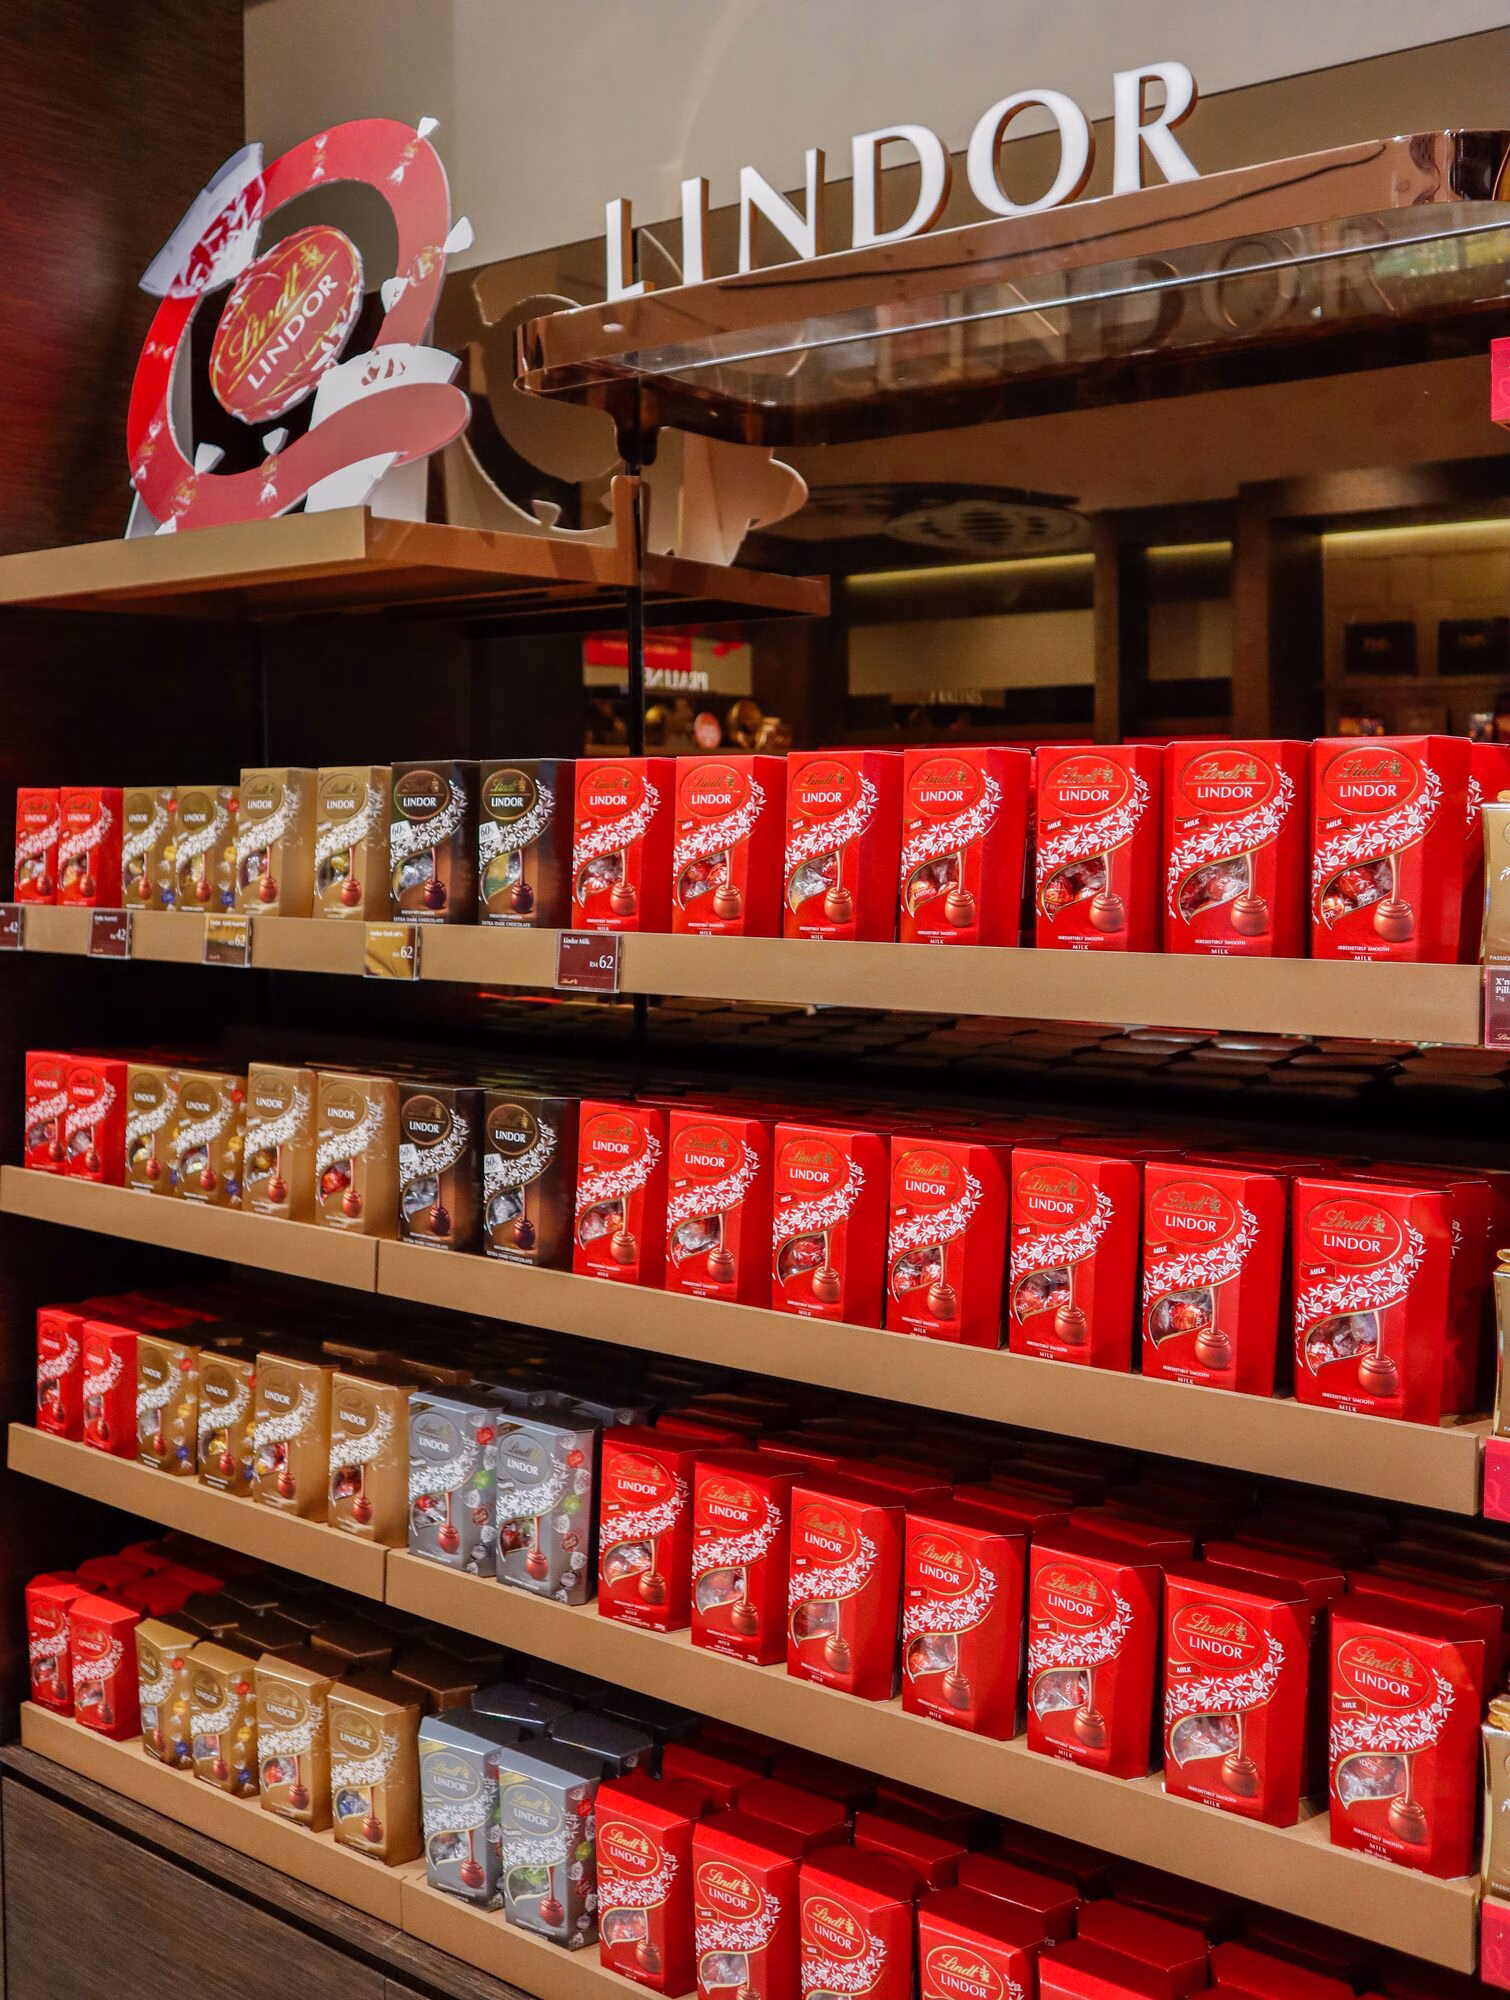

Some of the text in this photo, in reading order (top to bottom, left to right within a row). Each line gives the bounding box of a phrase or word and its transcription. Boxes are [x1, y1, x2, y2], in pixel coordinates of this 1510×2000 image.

[605, 61, 1199, 301] LINDOR
[228, 262, 299, 372] Lindt
[248, 274, 338, 389] LINDOR
[1056, 766, 1099, 784] Lindt
[1194, 763, 1243, 781] Lindt
[1339, 759, 1388, 778] Lindt
[802, 791, 842, 803] LINDOR
[920, 790, 964, 801] LINDOR
[1059, 789, 1109, 801] LINDOR
[1197, 786, 1252, 799] LINDOR
[1340, 784, 1397, 797] LINDOR
[247, 800, 272, 809] LINDOR
[326, 799, 355, 810] LINDOR
[403, 796, 436, 807] LINDOR
[491, 796, 523, 807] LINDOR
[589, 794, 627, 805] LINDOR
[691, 794, 731, 805] LINDOR
[909, 821, 923, 829] MILK
[1047, 820, 1062, 829] MILK
[1183, 819, 1200, 828] MILK
[1326, 818, 1343, 829] MILK
[116, 928, 126, 941] 42
[234, 934, 246, 946] 62
[400, 945, 413, 959] 62
[599, 955, 613, 969] 62
[1496, 986, 1510, 994] Pill
[256, 1098, 283, 1109] LINDOR
[327, 1108, 355, 1120] LINDOR
[409, 1121, 439, 1134] LINDOR
[495, 1130, 526, 1143] LINDOR
[592, 1141, 629, 1154] LINDOR
[685, 1154, 725, 1168] LINDOR
[790, 1168, 830, 1183] LINDOR
[905, 1180, 946, 1195] LINDOR
[1027, 1175, 1066, 1193] Lindt
[1029, 1198, 1074, 1214] LINDOR
[1163, 1192, 1210, 1211] Lindt
[1165, 1216, 1216, 1233] LINDOR
[1321, 1210, 1372, 1230] Lindt
[1018, 1227, 1031, 1235] MILK
[1153, 1245, 1168, 1254] MILK
[1323, 1234, 1381, 1252] LINDOR
[1310, 1266, 1326, 1276] MILK
[1178, 1376, 1194, 1385] MILK
[264, 1390, 290, 1404] LINDOR
[1339, 1404, 1357, 1412] MILK
[340, 1412, 366, 1427] LINDOR
[419, 1437, 449, 1452] LINDOR
[507, 1458, 538, 1475] LINDOR
[617, 1479, 657, 1496] LINDOR
[709, 1504, 749, 1521] LINDOR
[804, 1532, 843, 1554] LINDOR
[919, 1563, 960, 1585] LINDOR
[1047, 1572, 1087, 1595] Lindt
[1048, 1594, 1094, 1617] LINDOR
[1037, 1622, 1050, 1630] MILK
[1187, 1613, 1236, 1636] Lindt
[1189, 1636, 1243, 1659] LINDOR
[1352, 1647, 1400, 1672] Lindt
[1176, 1666, 1192, 1674] MILK
[1354, 1670, 1410, 1698] LINDOR
[267, 1704, 297, 1719] LINDOR
[1341, 1701, 1357, 1710] MILK
[340, 1732, 371, 1751] LINDOR
[1058, 1749, 1073, 1758] MILK
[433, 1775, 468, 1794] LINDOR
[1203, 1799, 1220, 1808] MILK
[513, 1808, 549, 1828] LINDOR
[609, 1828, 642, 1849] Lindt
[1369, 1842, 1387, 1854] MILK
[610, 1846, 647, 1868] LINDOR
[707, 1869, 742, 1890] Lindt
[708, 1887, 748, 1910] LINDOR
[812, 1905, 845, 1929] Lindt
[814, 1924, 852, 1950] LINDOR
[938, 1954, 980, 1977] Lindt
[941, 1973, 987, 1999] LINDOR
